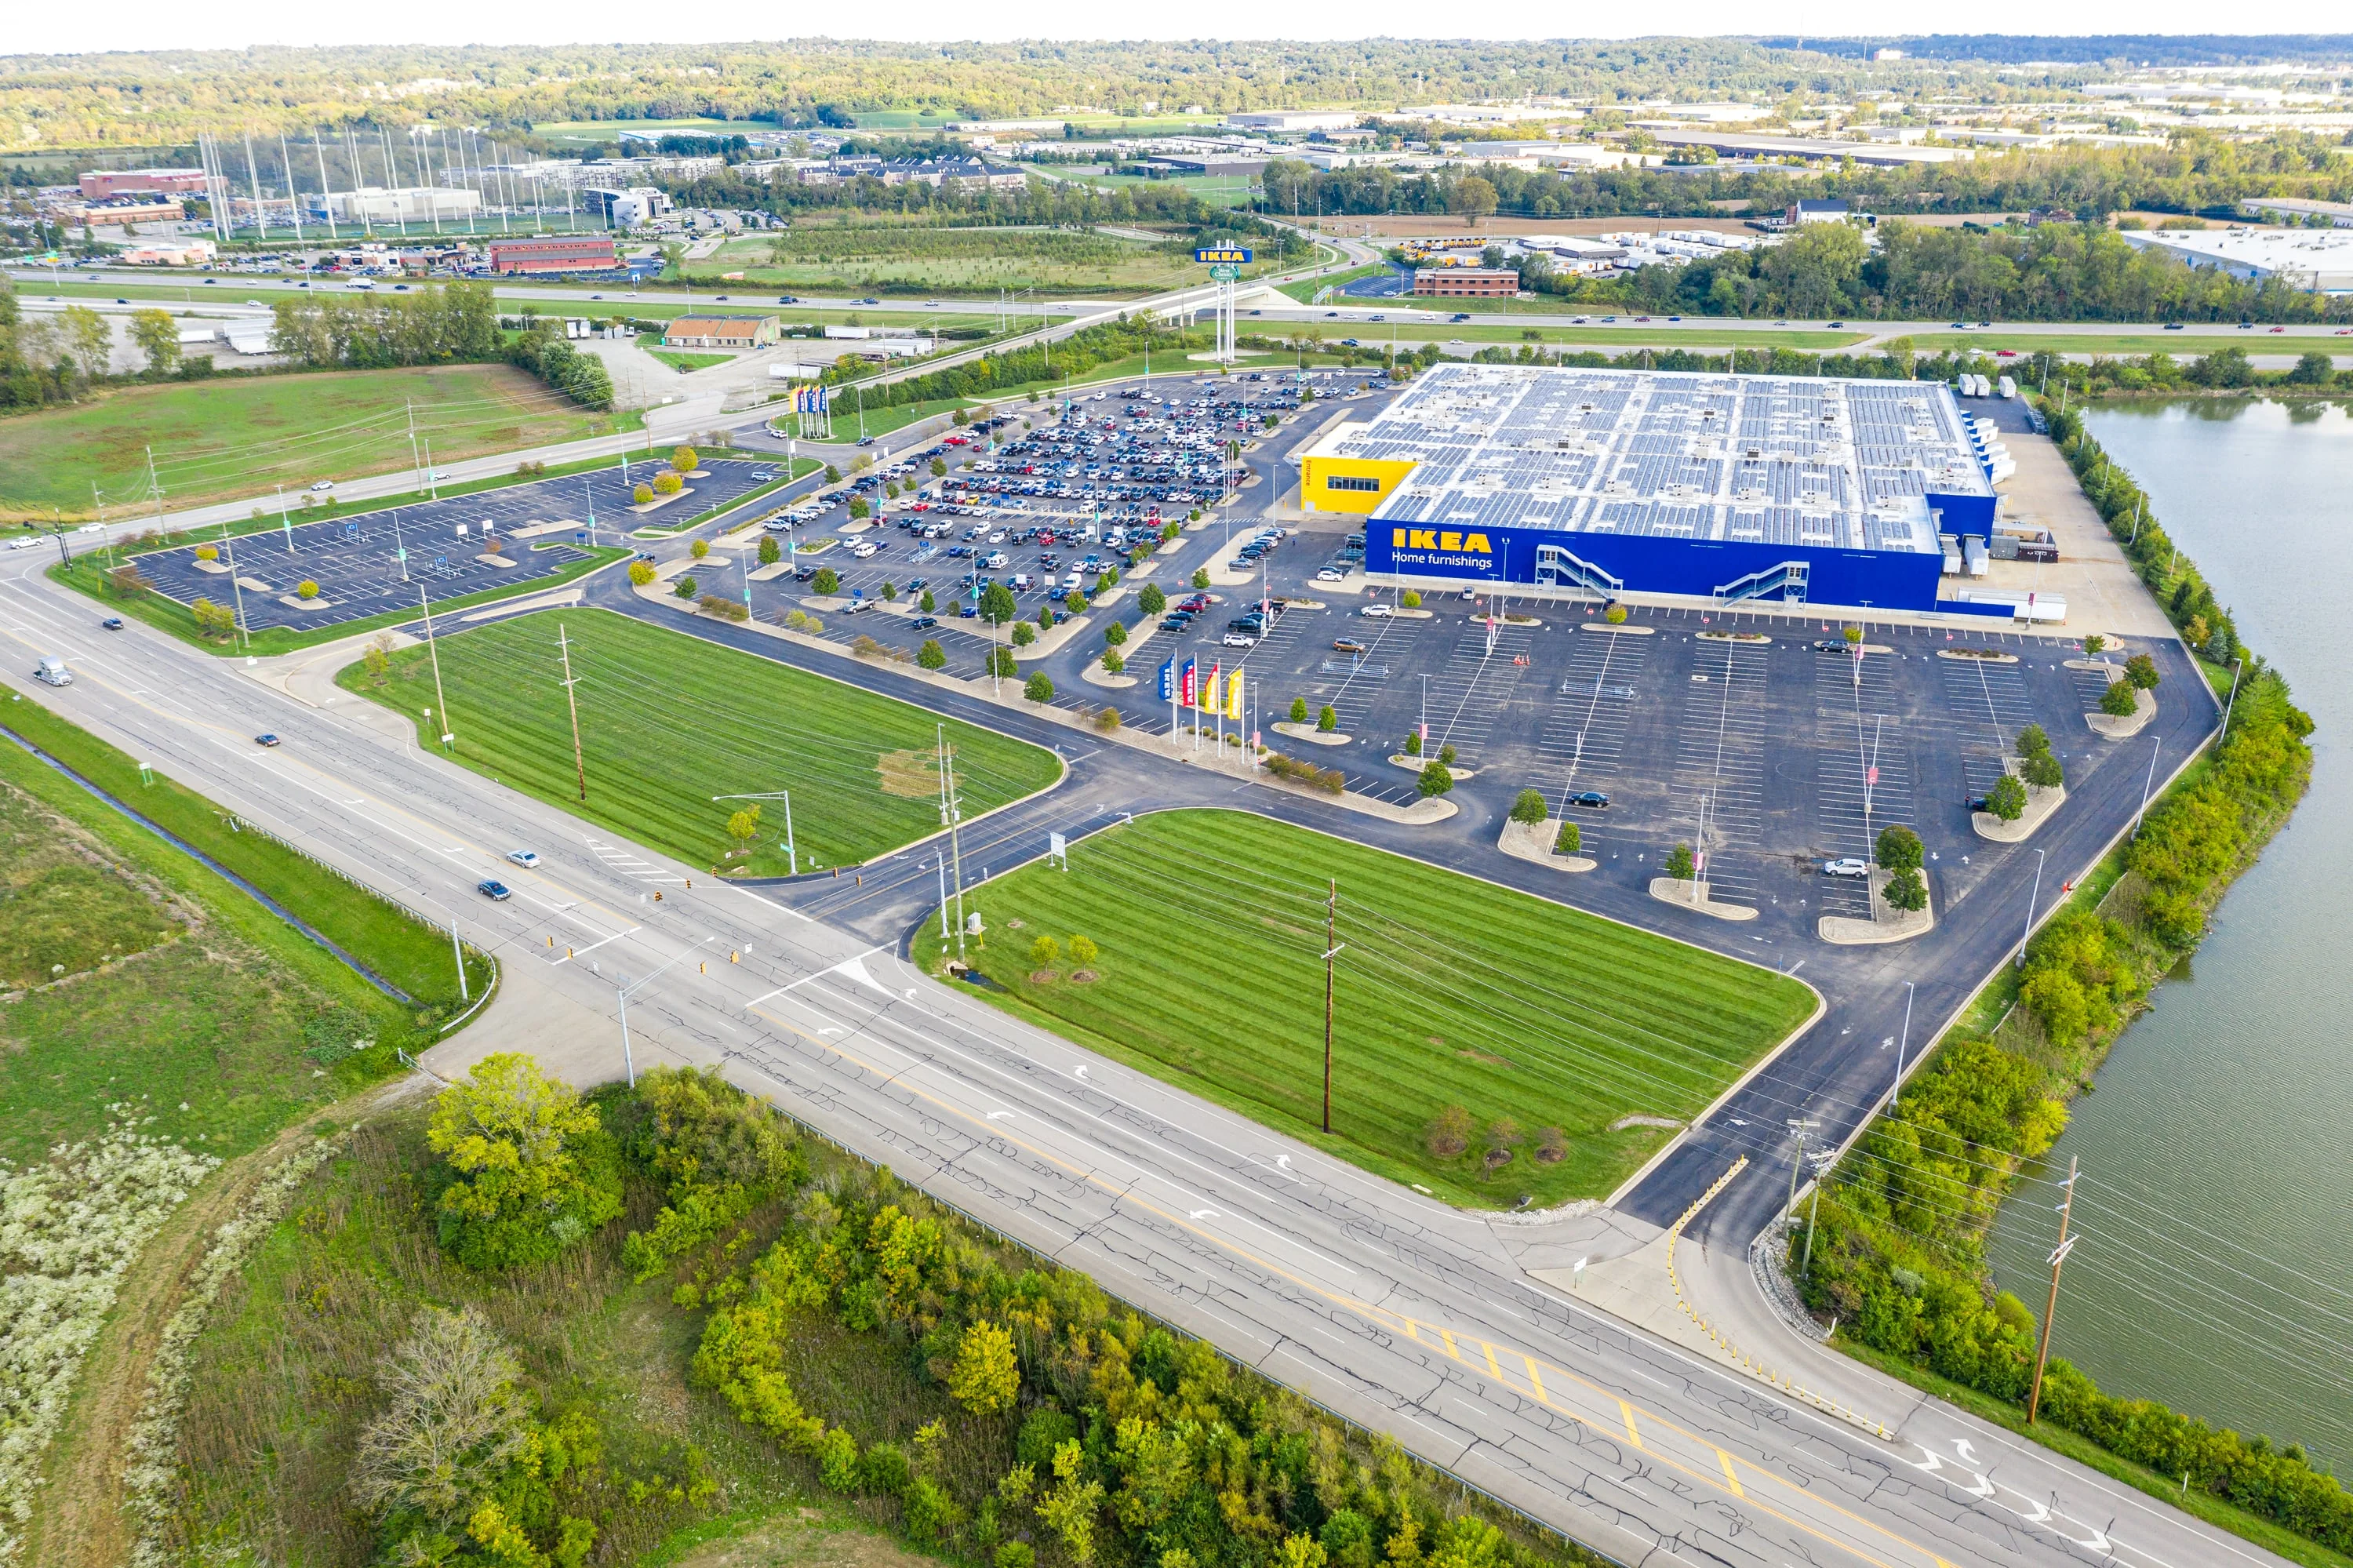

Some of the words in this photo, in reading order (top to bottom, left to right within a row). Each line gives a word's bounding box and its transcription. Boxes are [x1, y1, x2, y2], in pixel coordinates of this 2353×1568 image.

[1200, 251, 1245, 261] IKEA
[1393, 528, 1493, 554] IKEA
[1392, 551, 1425, 563] Home
[1427, 554, 1493, 569] furnishings
